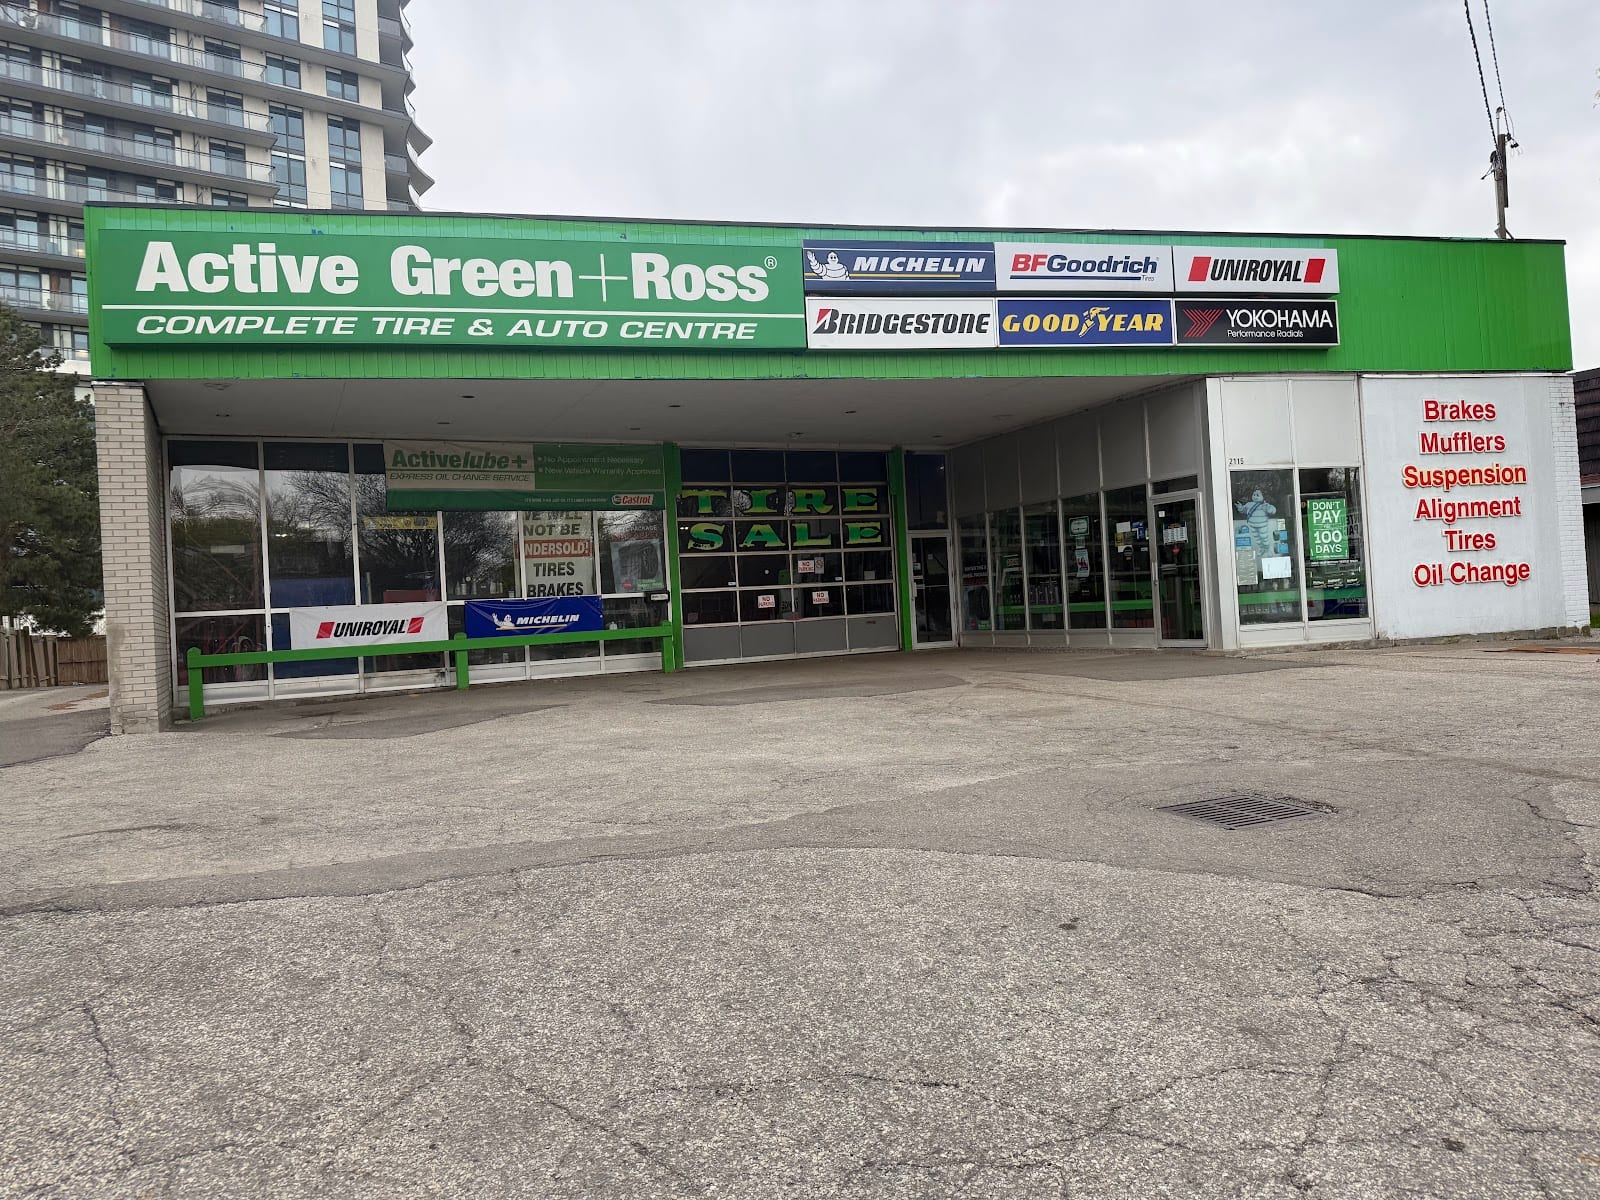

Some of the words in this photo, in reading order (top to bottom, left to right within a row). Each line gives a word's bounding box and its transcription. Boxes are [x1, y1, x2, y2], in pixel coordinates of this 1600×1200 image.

[135, 241, 359, 293] Active
[853, 256, 986, 273] MICHELIN
[1011, 253, 1157, 274] BFGoodrich
[1209, 259, 1304, 282] UNIROYAL
[136, 315, 358, 335] COMPLETE
[372, 317, 455, 336] TIRE
[467, 319, 495, 336] &
[506, 319, 608, 338] AUTO
[619, 321, 758, 340] CENTRE
[813, 308, 991, 334] BRIDGESTONE
[1225, 308, 1333, 328] YOKOHAMA
[1227, 330, 1275, 338] Performance
[1276, 330, 1303, 338] Radials
[1423, 399, 1497, 422] Brakes
[1420, 431, 1506, 454] Mufflers
[389, 472, 433, 480] EXPRESS
[435, 473, 450, 481] OIL
[451, 473, 491, 481] CHANGE
[492, 474, 529, 482] SERVICE
[544, 467, 563, 475] New
[1403, 463, 1527, 491] Suspension
[622, 495, 652, 505] Castrol
[681, 488, 878, 515] TIRE
[1312, 501, 1341, 510] DON'T
[1313, 510, 1342, 523] PAY
[1415, 496, 1522, 524] Alignment
[523, 524, 556, 536] NOT
[560, 523, 581, 535] BE
[687, 522, 882, 551] SALE
[1313, 530, 1343, 543] 100
[517, 541, 589, 556] NDERSOLD!
[1315, 544, 1343, 554] DAYS
[1443, 530, 1497, 551] Tires
[533, 562, 575, 577] TIRES
[1413, 563, 1444, 586] Oil
[1450, 561, 1531, 586] Change
[527, 582, 584, 598] BRAKES
[333, 619, 408, 638] UNIROYAL
[516, 613, 581, 625] MICHELIN
